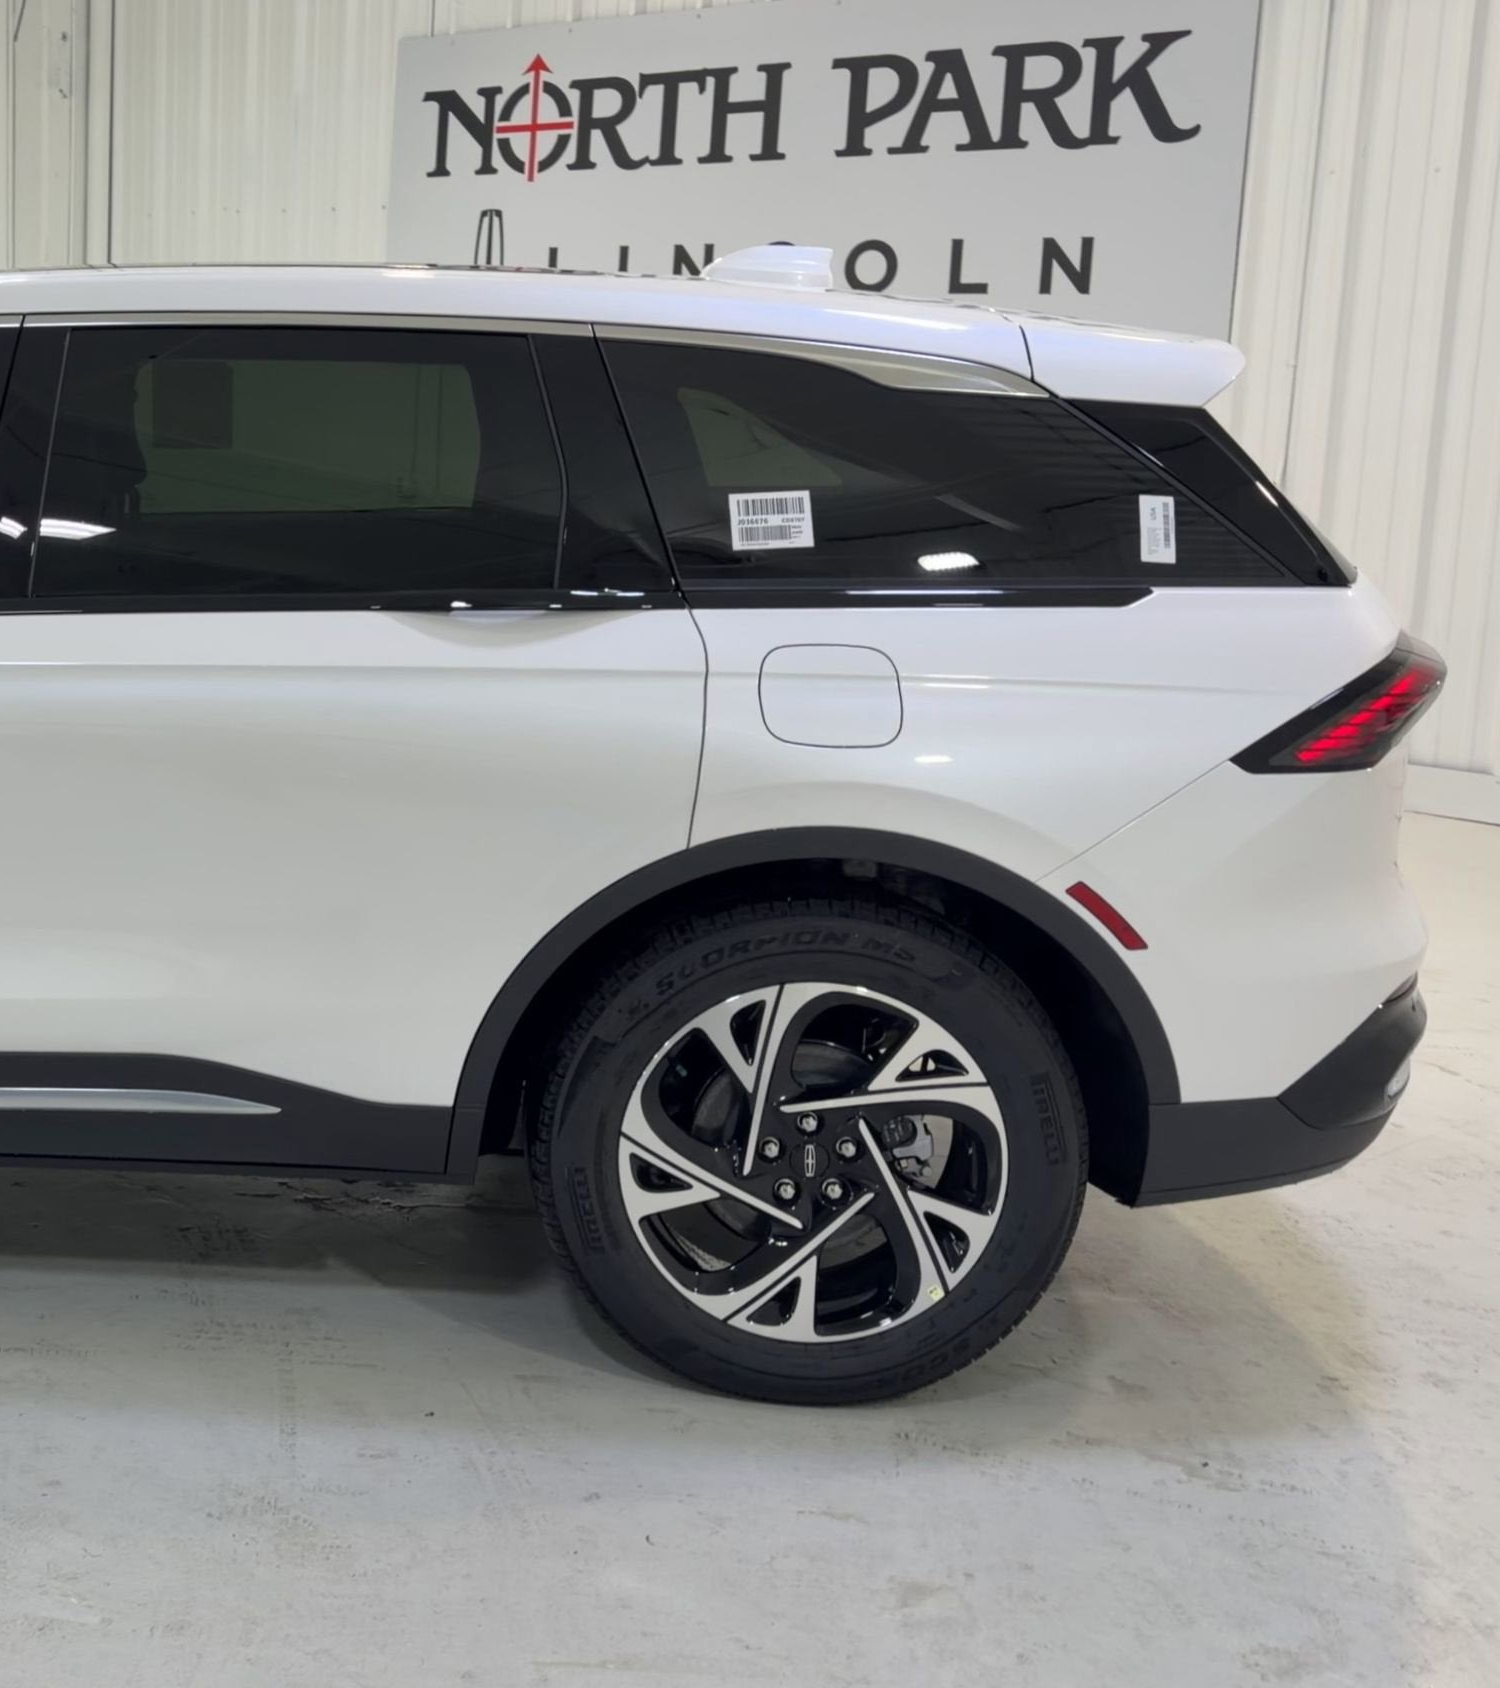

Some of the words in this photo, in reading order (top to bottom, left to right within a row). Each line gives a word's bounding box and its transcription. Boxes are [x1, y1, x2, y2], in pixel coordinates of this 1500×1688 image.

[422, 60, 792, 179] NORTH
[832, 28, 1202, 159] PARK
[548, 236, 1095, 296] INOLN
[655, 929, 851, 994] SCORPION
[1030, 1072, 1067, 1166] PIRELLI
[567, 1165, 605, 1255] PIRELLI
